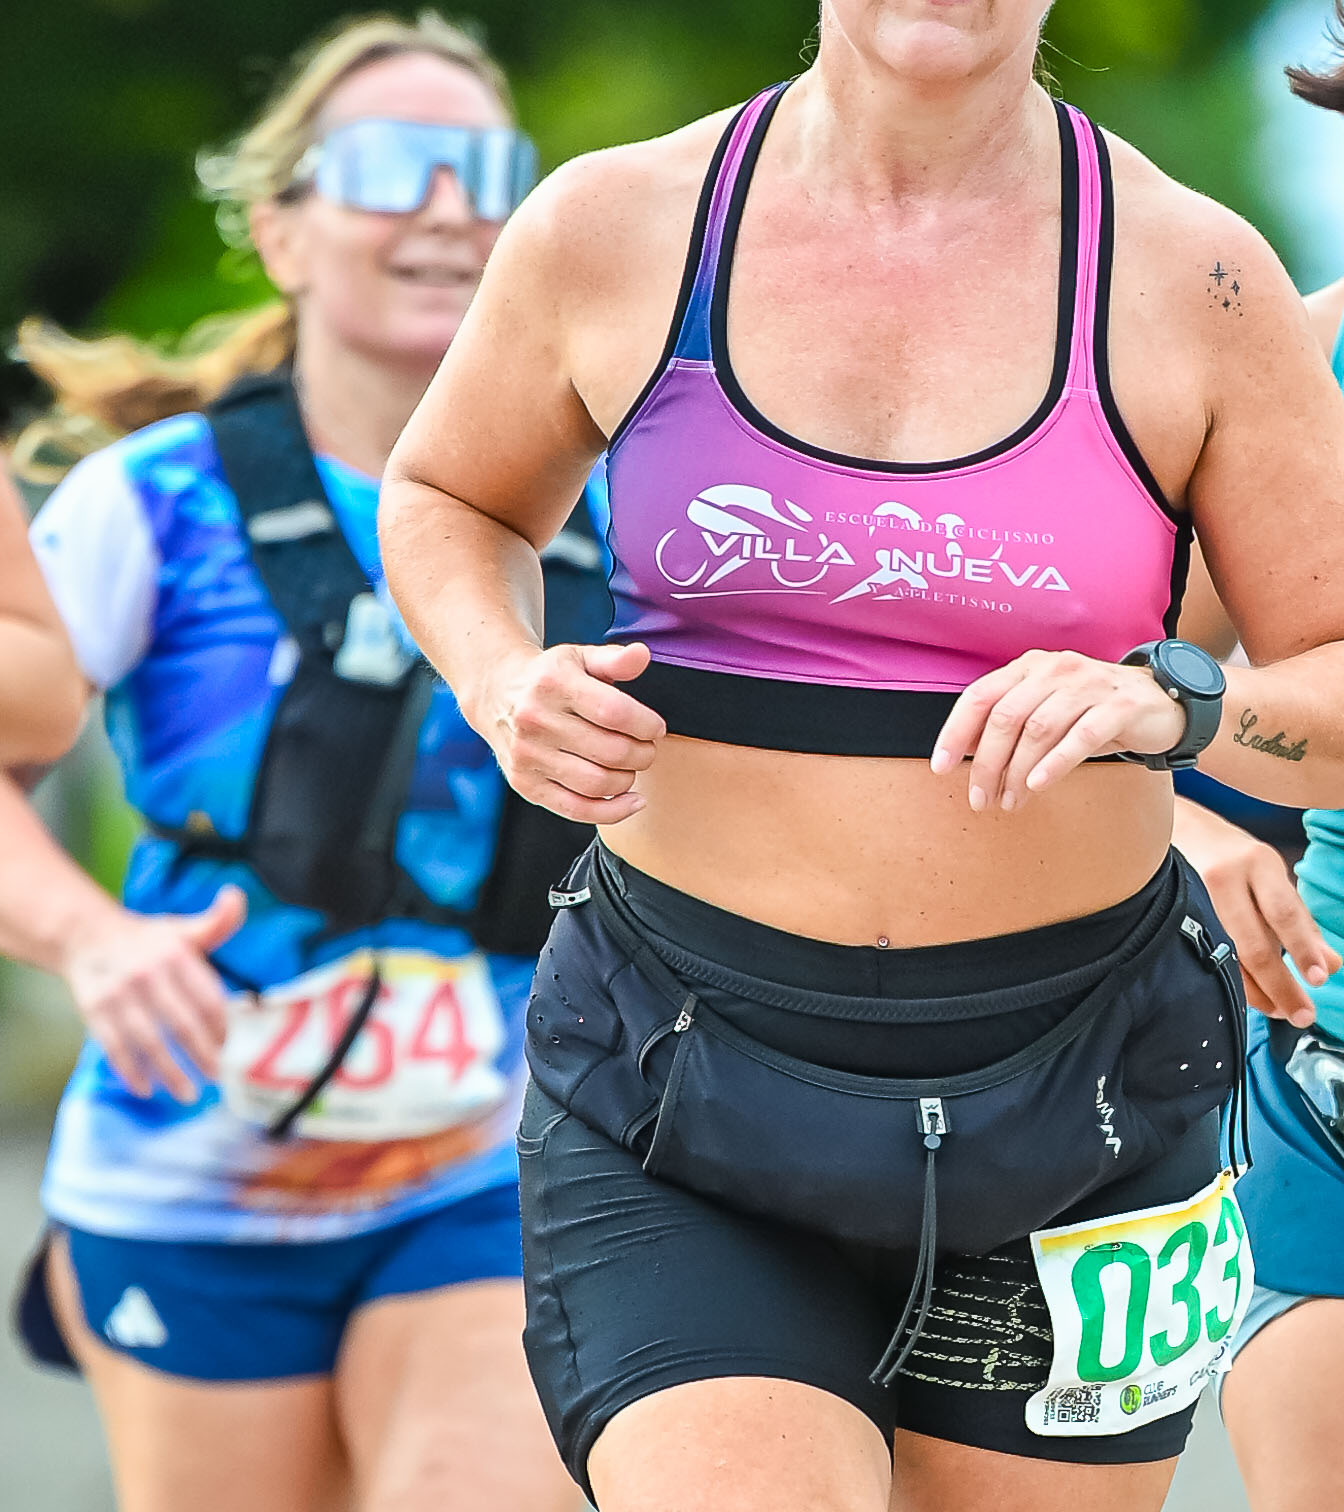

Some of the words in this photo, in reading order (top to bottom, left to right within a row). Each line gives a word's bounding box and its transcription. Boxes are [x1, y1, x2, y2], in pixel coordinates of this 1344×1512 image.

[824, 511, 914, 530] ESCUELA
[919, 522, 946, 536] DE
[954, 525, 1056, 545] CICLISMO
[701, 530, 856, 567] VILLA
[890, 547, 1071, 592] NUEVA
[1071, 1196, 1244, 1383] 033
